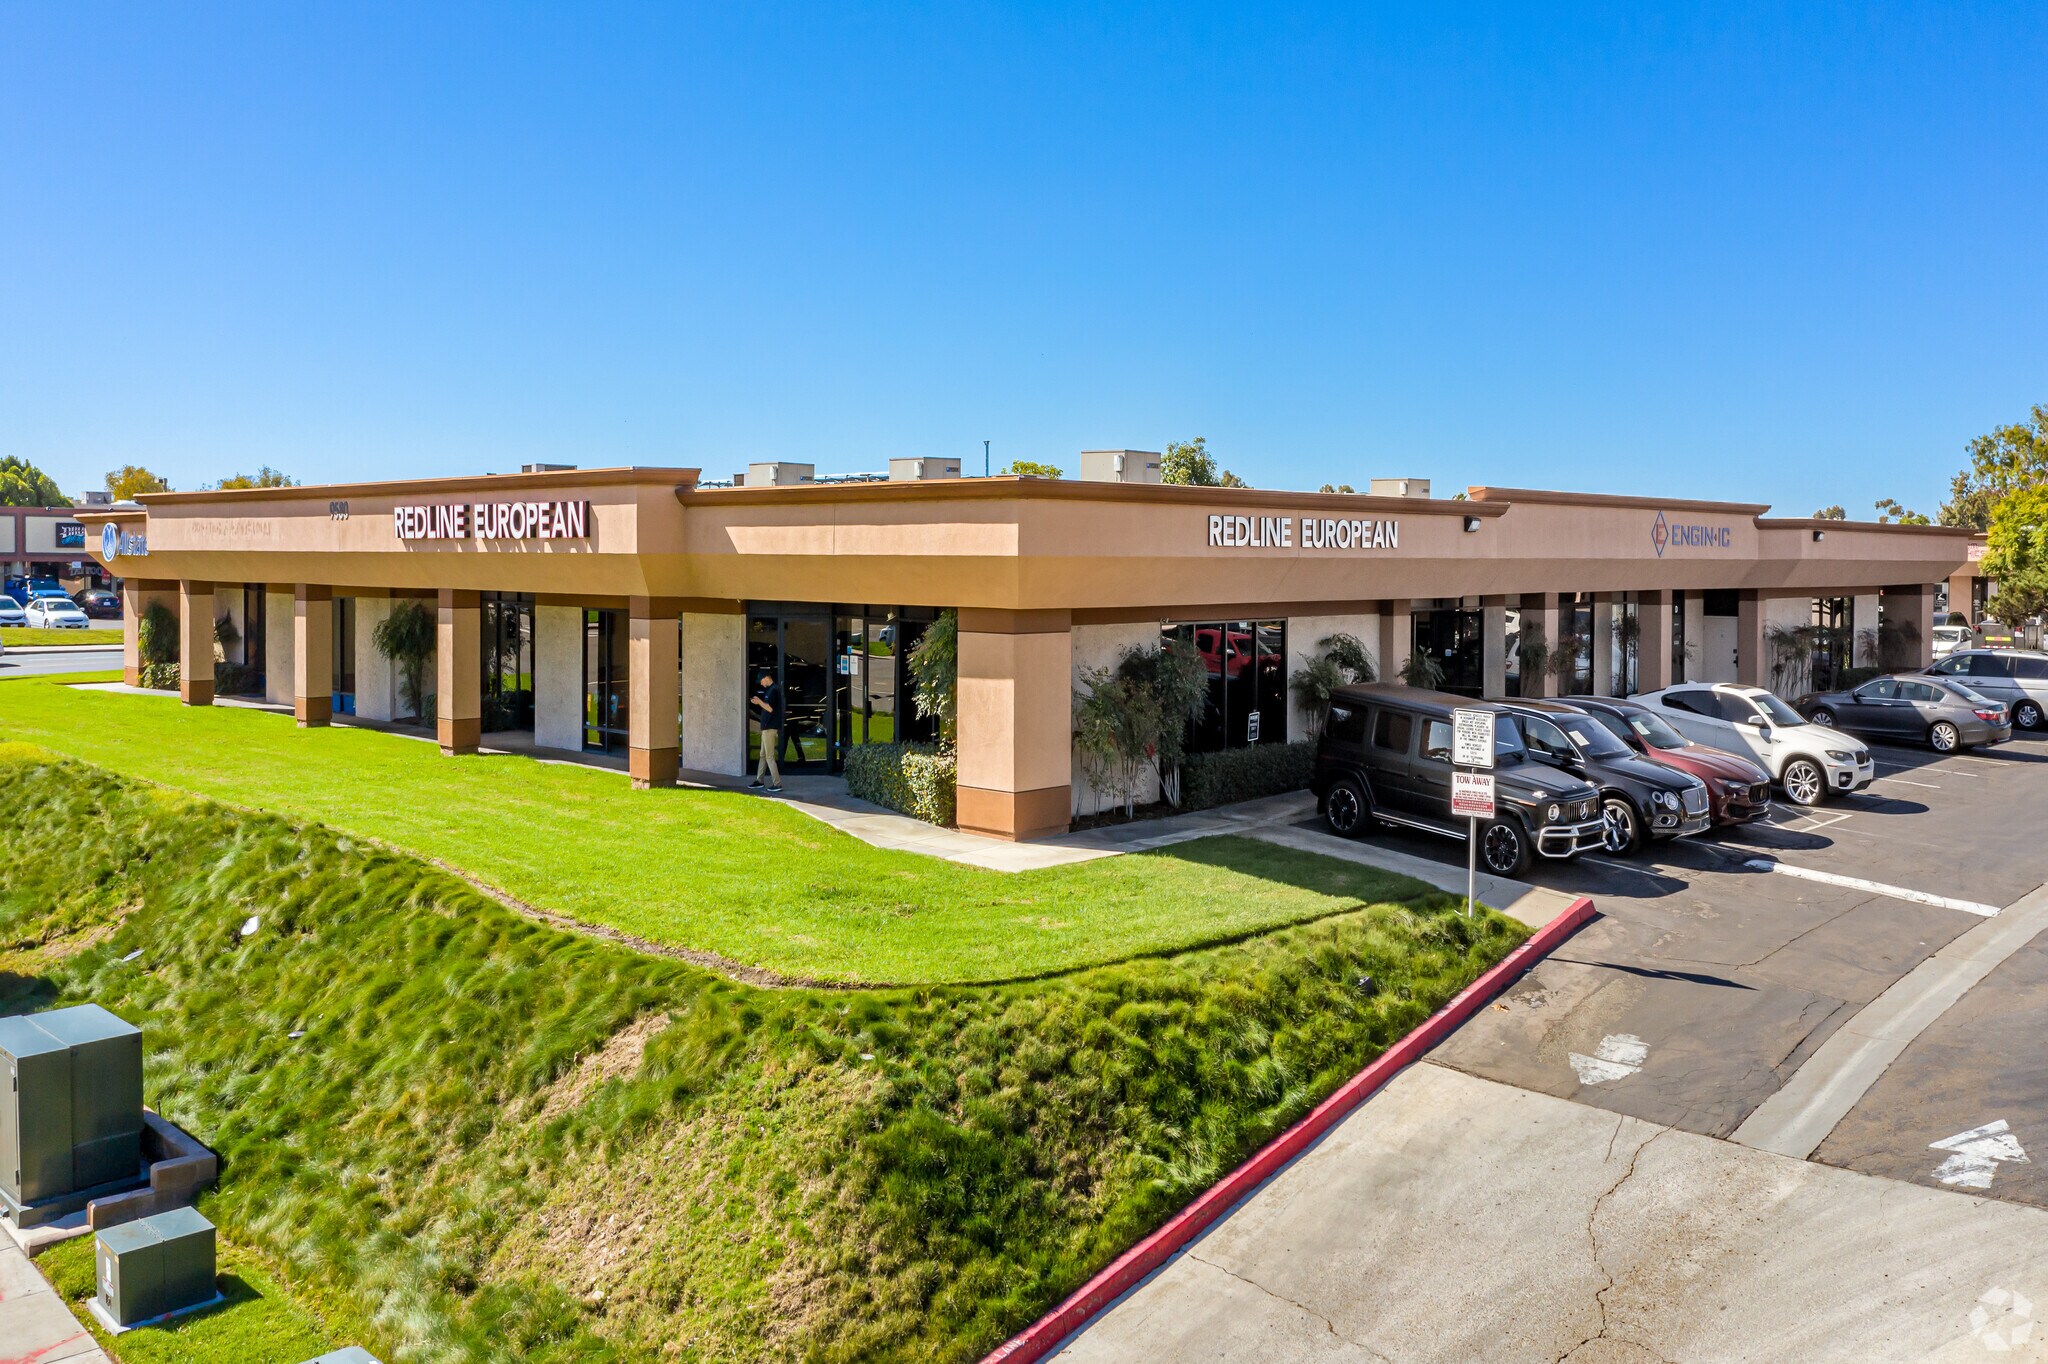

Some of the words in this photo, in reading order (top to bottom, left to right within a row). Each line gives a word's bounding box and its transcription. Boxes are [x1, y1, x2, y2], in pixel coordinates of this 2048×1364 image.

[394, 504, 469, 539] REDLINE
[474, 501, 589, 540] EUROPEAN
[1208, 515, 1292, 548] REDLINE
[1300, 518, 1399, 549] EUROPEAN
[117, 531, 149, 556] Allstate
[1456, 776, 1470, 785] TOW
[1472, 776, 1491, 786] AWAY
